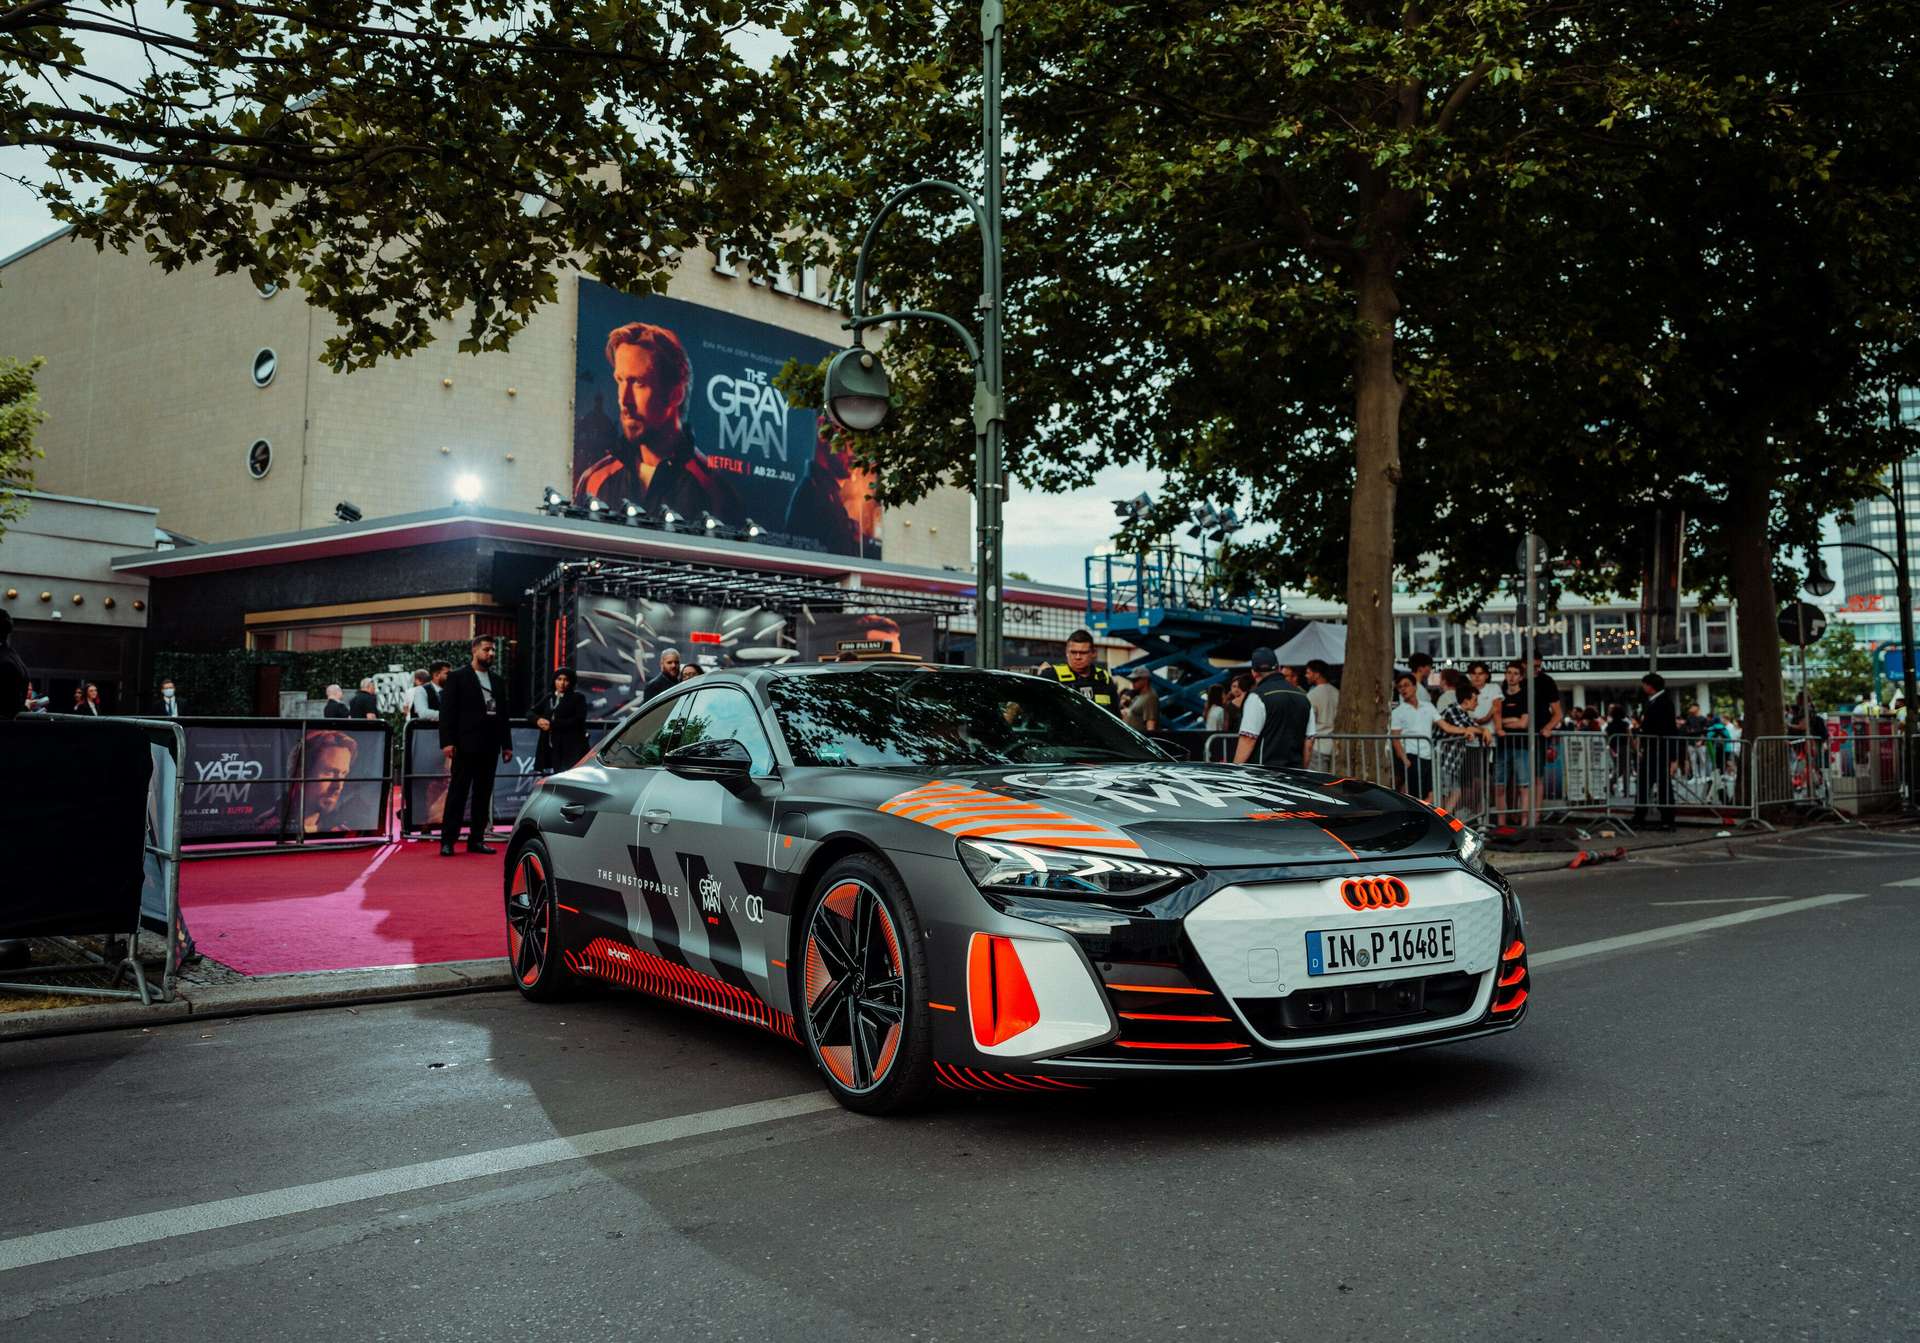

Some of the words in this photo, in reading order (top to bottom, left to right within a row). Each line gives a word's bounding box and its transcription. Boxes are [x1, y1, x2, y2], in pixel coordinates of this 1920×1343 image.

[744, 368, 767, 385] THE
[707, 374, 790, 427] GRAY
[719, 414, 787, 461] MAN
[707, 455, 743, 474] NETFLIX
[753, 466, 765, 477] AB
[779, 471, 795, 481] JULI
[1001, 606, 1043, 626] COME
[1540, 660, 1590, 671] ANIEREN
[597, 869, 612, 881] THE
[616, 873, 679, 897] UNSTOPPABLE
[699, 878, 721, 897] GRAY
[702, 895, 721, 914] MAN
[608, 948, 631, 962] e-tron
[1327, 934, 1356, 968] IN
[1312, 958, 1319, 968] D
